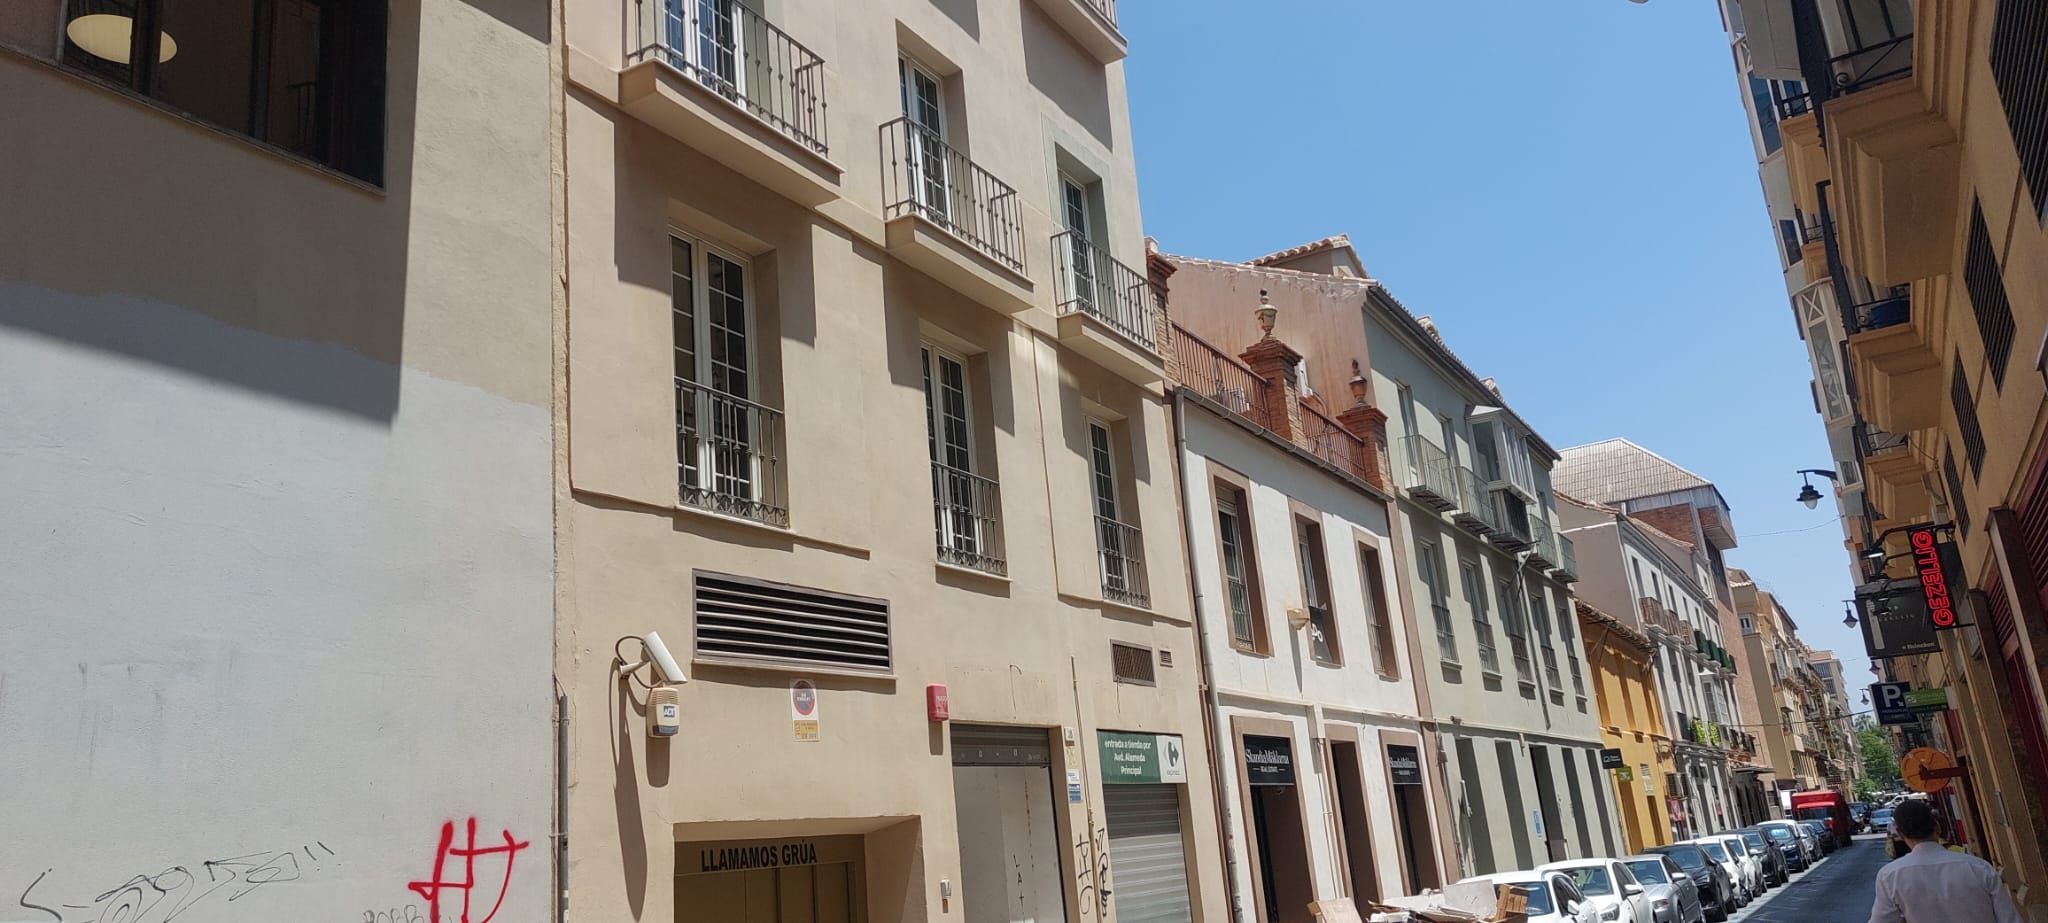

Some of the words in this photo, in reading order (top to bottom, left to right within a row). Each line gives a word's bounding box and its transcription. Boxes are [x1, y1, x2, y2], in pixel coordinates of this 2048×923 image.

[1911, 530, 1953, 627] GEZELLIG
[1881, 684, 1902, 708] P
[1104, 740, 1124, 749] entrada
[1128, 741, 1143, 750] tienda
[1143, 742, 1151, 751] por
[1125, 753, 1146, 762] Alameda
[1120, 766, 1142, 776] Principal
[701, 846, 778, 872] LLAMAMOS
[781, 839, 818, 866] GRÚA
